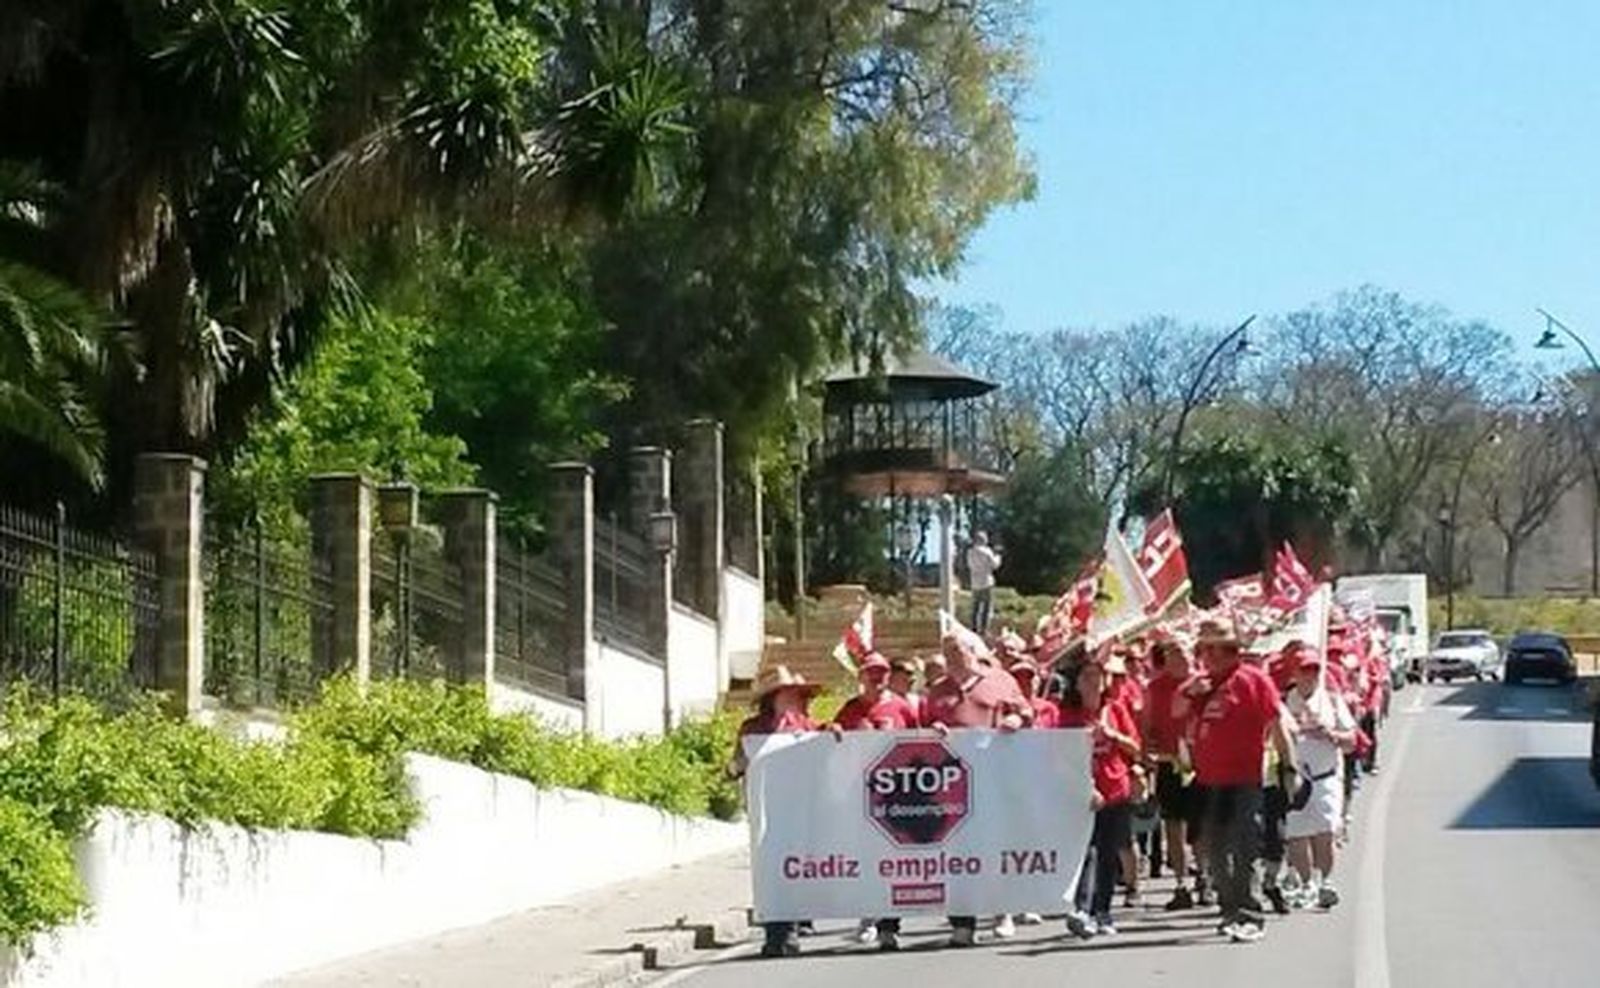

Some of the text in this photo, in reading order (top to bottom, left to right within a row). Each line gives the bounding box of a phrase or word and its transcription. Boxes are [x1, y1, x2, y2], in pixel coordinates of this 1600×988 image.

[874, 766, 962, 794] STOP
[783, 853, 860, 879] Cádiz
[878, 851, 982, 881] empleo
